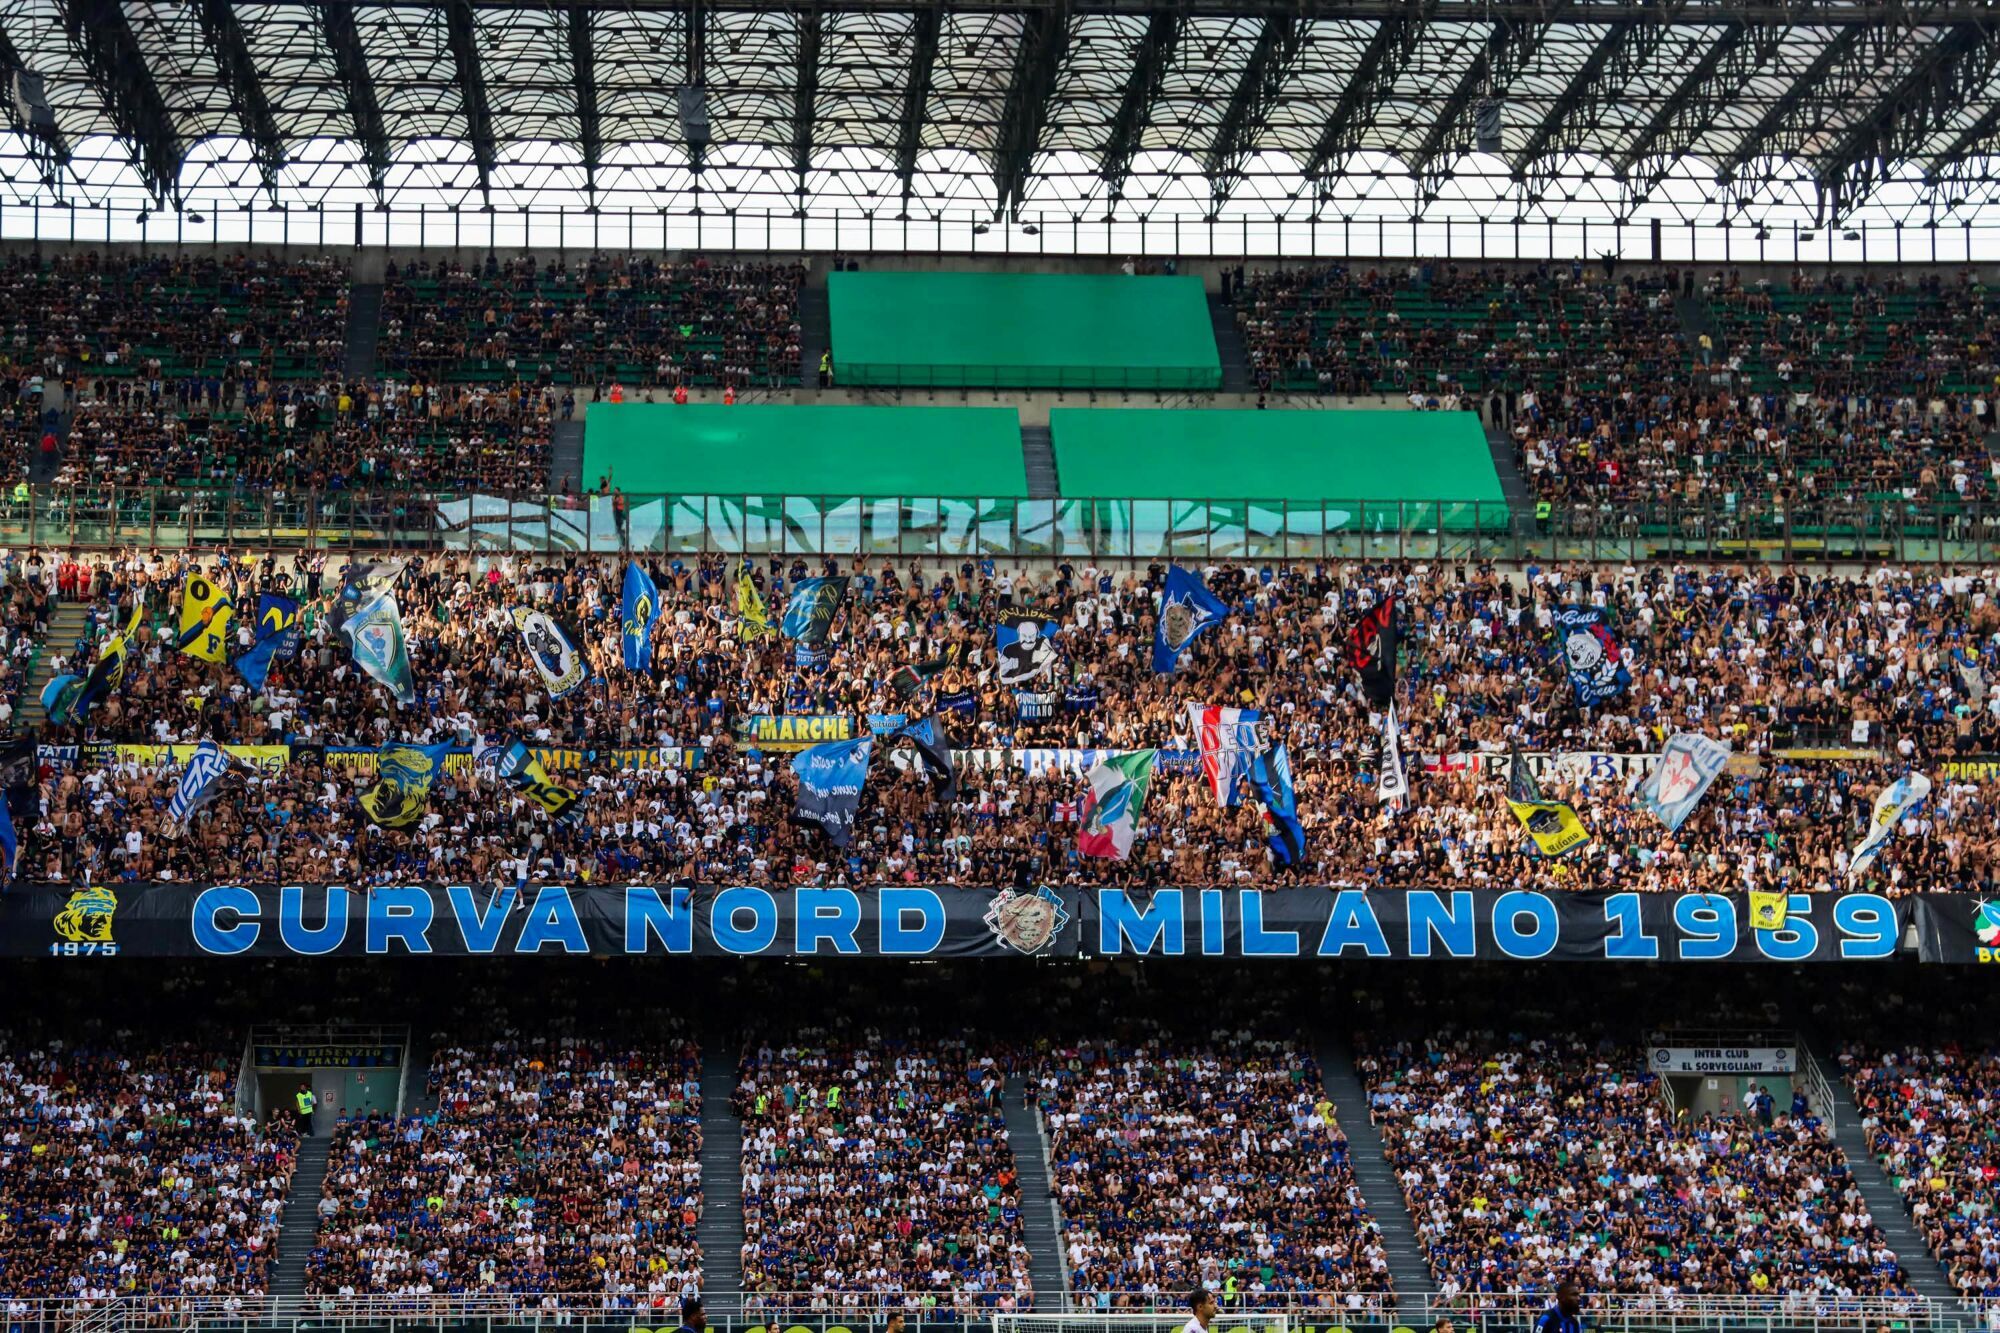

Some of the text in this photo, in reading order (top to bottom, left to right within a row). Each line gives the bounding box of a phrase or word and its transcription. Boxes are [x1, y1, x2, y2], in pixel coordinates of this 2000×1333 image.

[758, 717, 849, 740] MARCHE
[37, 744, 80, 759] FATTI
[191, 886, 1899, 959] CURVA NORD MILANO 1969
[52, 942, 117, 957] 1975
[305, 1057, 350, 1066] PRATO
[1694, 1049, 1750, 1059] INTER CLUB
[1681, 1061, 1693, 1071] EL
[1695, 1061, 1763, 1071] SORVEGLIANT
